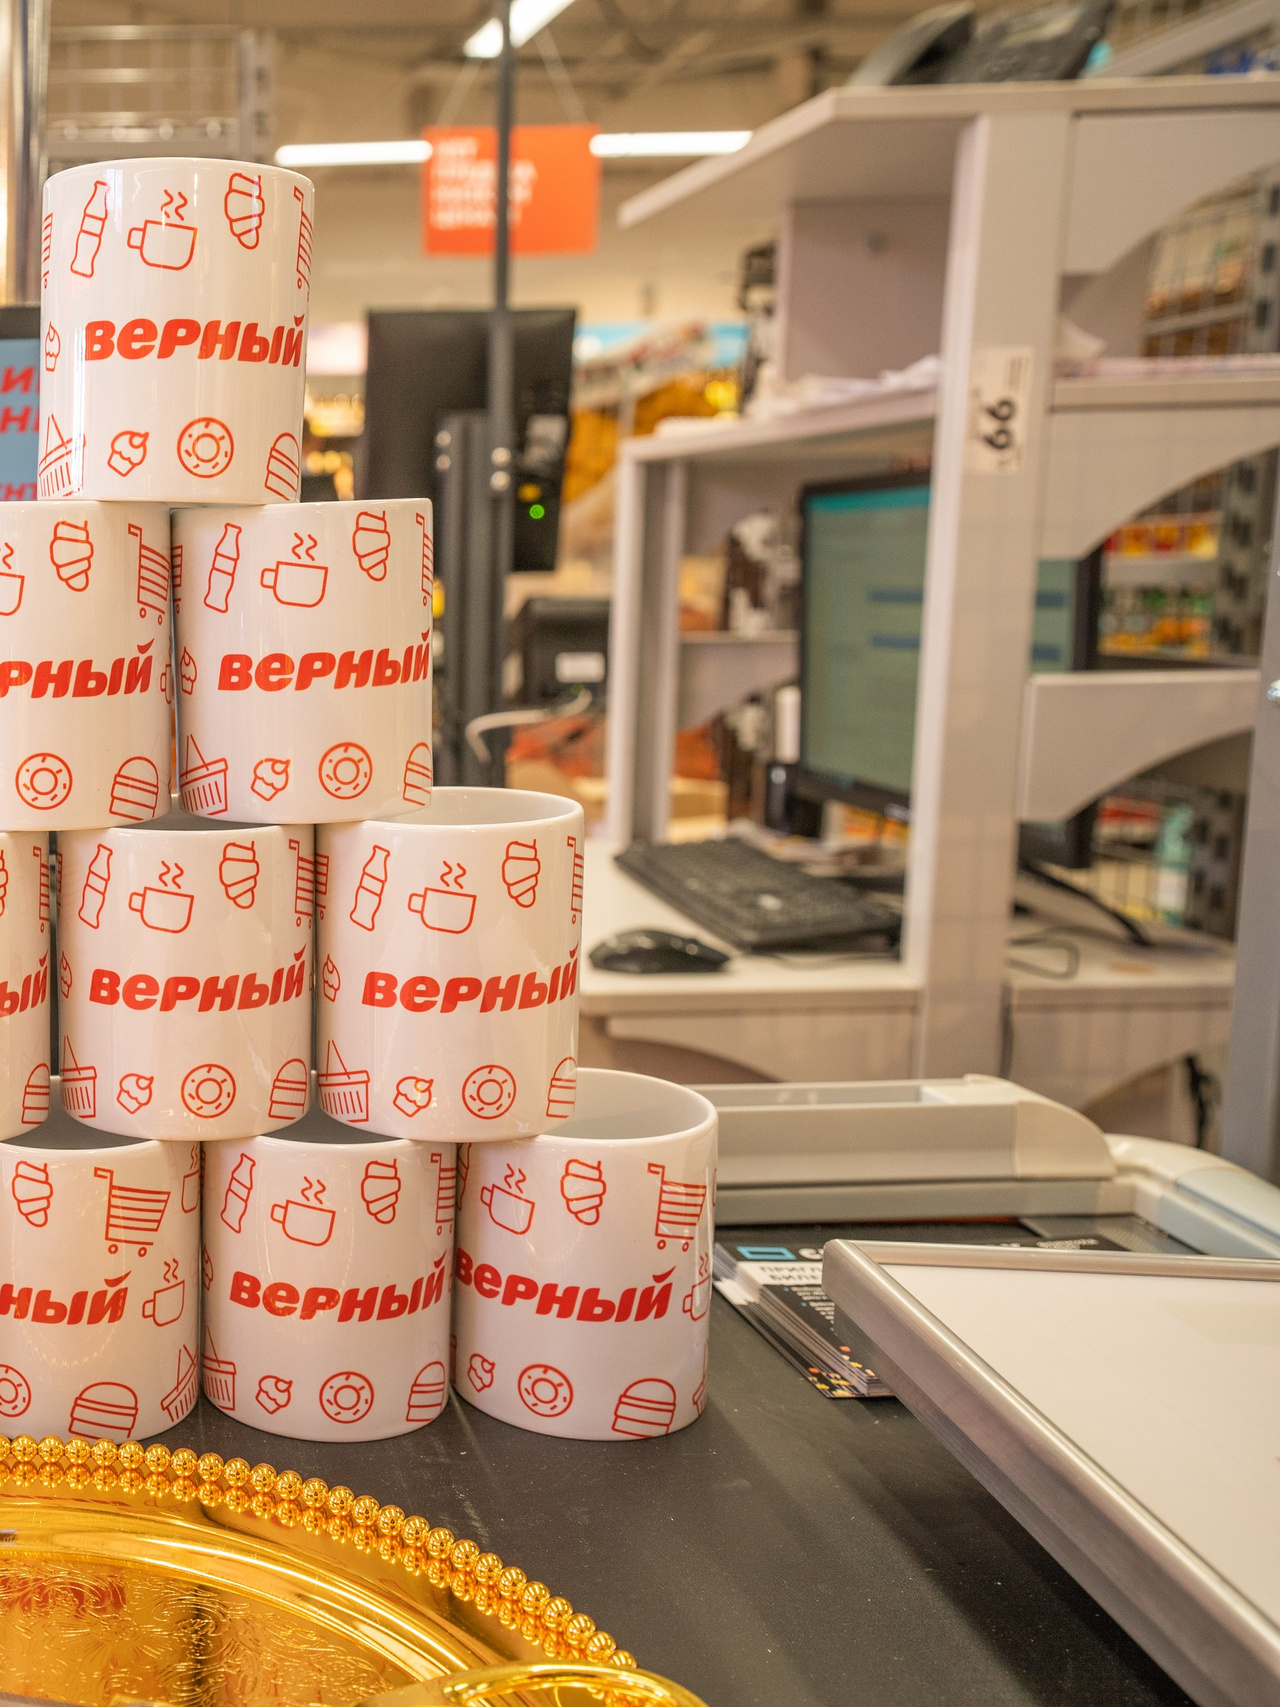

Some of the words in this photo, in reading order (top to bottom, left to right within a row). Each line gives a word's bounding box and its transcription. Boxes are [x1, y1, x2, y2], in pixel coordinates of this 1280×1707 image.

[85, 313, 305, 367] верный
[218, 627, 431, 692] верный
[89, 943, 307, 1013] верный
[362, 941, 579, 1014] верный
[230, 1249, 448, 1323] верный
